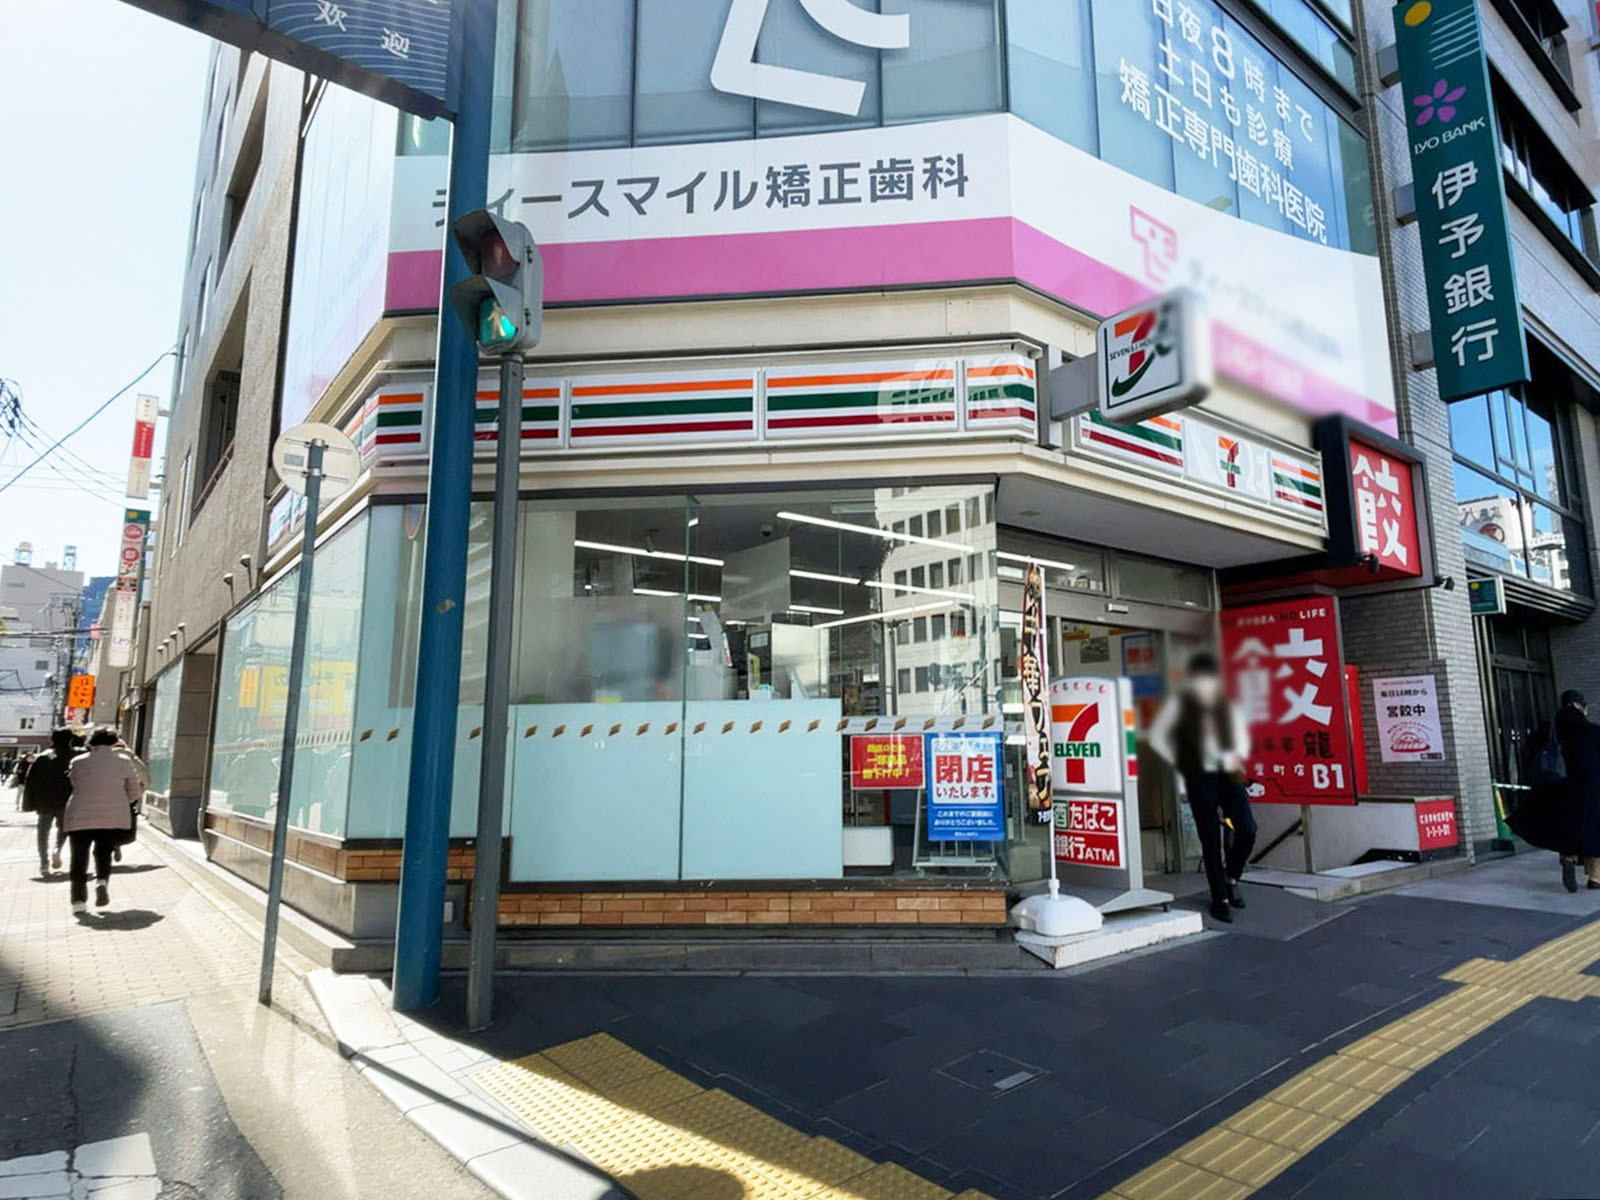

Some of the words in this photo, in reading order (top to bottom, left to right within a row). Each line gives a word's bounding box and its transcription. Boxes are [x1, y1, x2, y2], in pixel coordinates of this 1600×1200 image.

[1159, 39, 1294, 171] 土日も診療
[1119, 57, 1328, 244] 矯正専門歯科医院
[1414, 136, 1440, 155] IYO
[1442, 117, 1486, 143] BANK
[1431, 160, 1499, 367] 伊予銀行
[1352, 453, 1407, 566] 餃
[1300, 608, 1326, 619] LIFE
[935, 754, 993, 784] 閉店
[1312, 763, 1345, 790] B1
[936, 786, 995, 799] いたします。
[1070, 803, 1116, 831] たばこ
[1055, 834, 1115, 862] 銀行ATM
